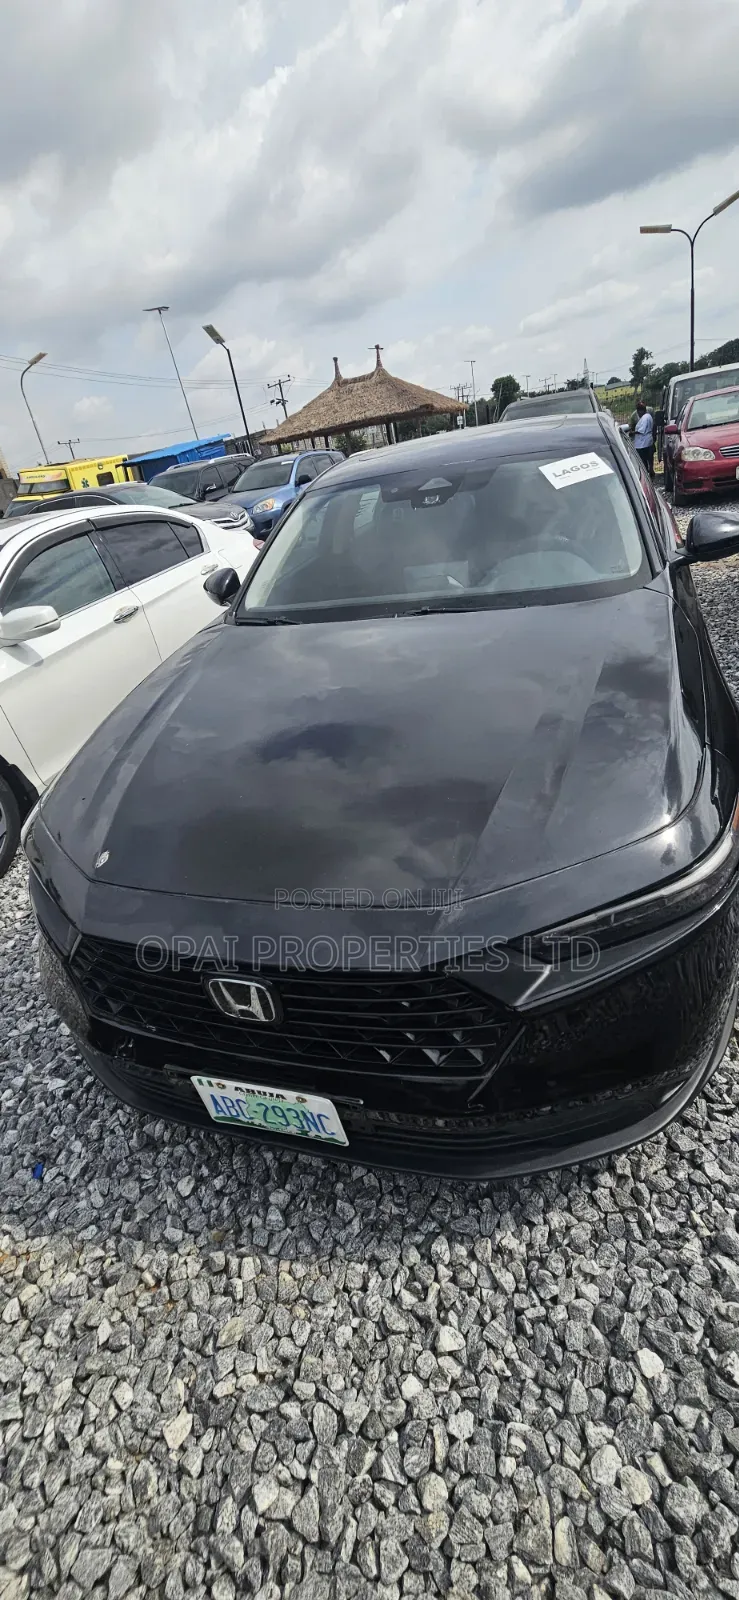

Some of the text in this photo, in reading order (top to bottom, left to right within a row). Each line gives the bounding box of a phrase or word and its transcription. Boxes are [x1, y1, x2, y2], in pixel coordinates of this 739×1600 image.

[552, 461, 598, 478] LAGOS
[234, 1086, 287, 1100] ABUJA
[209, 1093, 336, 1136] ABC-293NC
